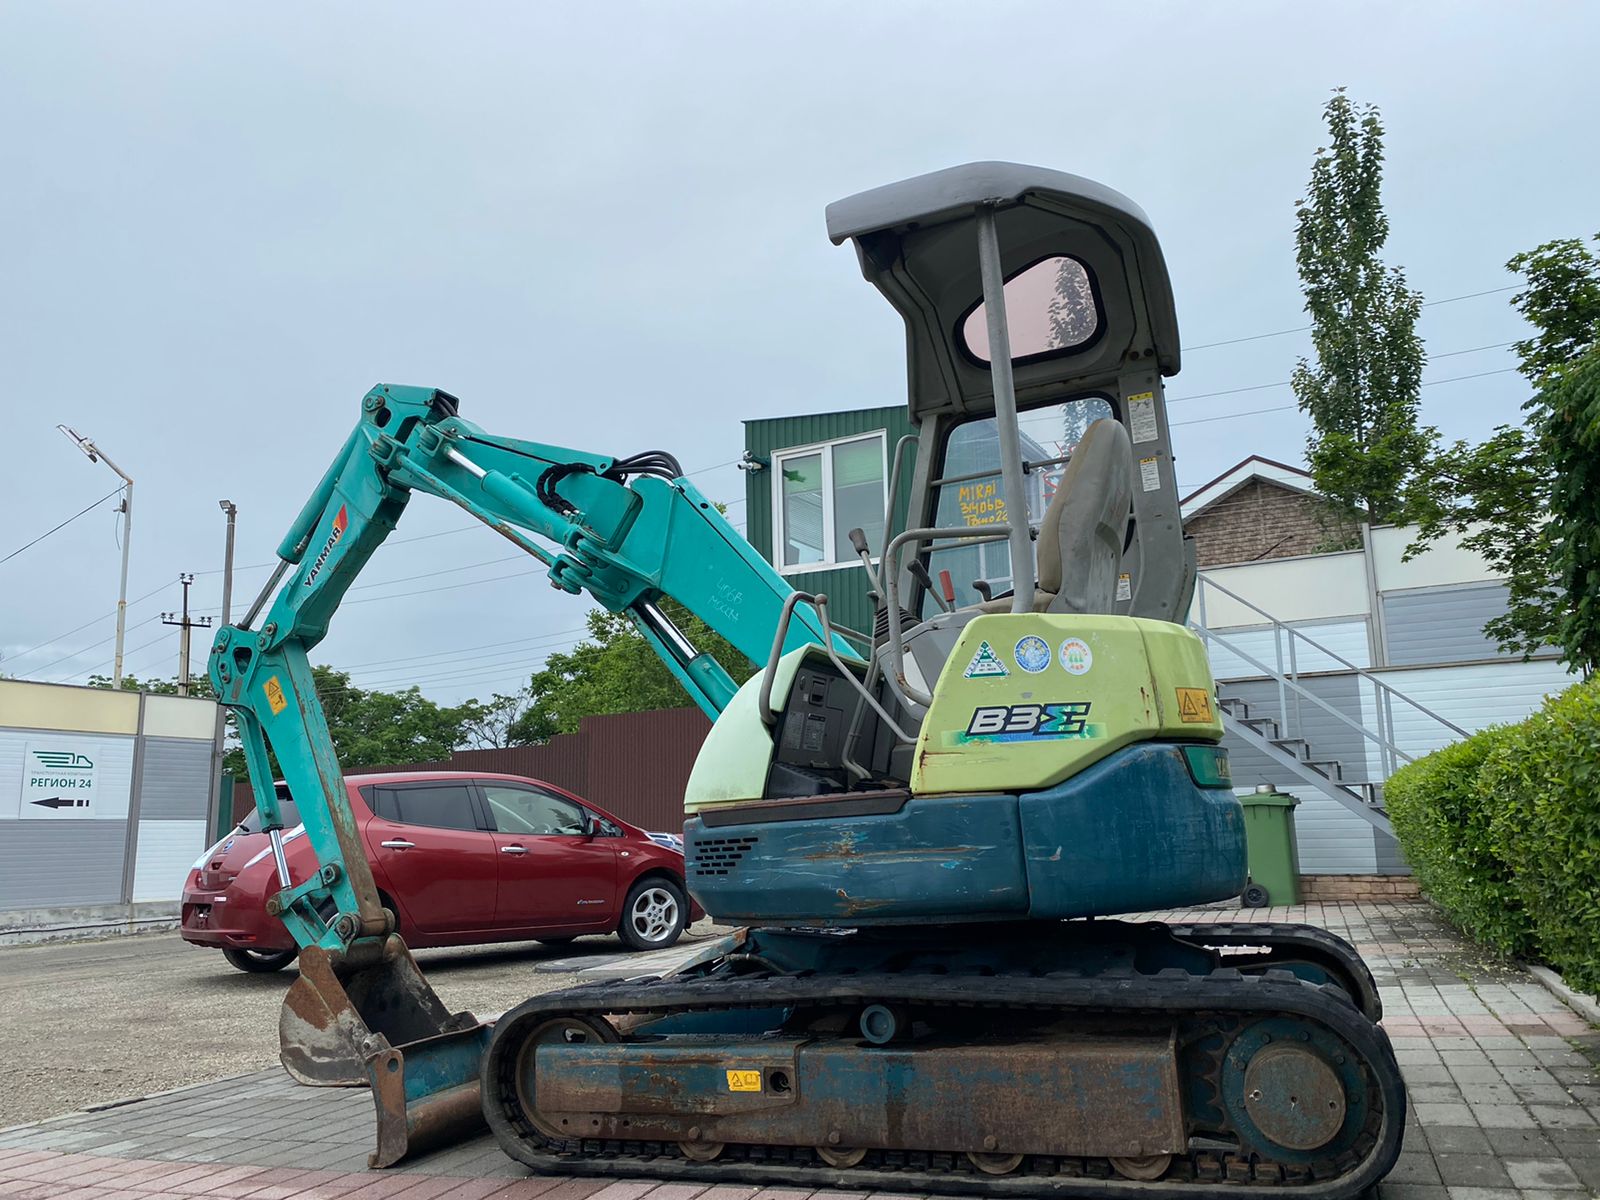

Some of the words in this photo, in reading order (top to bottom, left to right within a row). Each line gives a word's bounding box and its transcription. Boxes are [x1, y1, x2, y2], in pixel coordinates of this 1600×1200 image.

[303, 526, 342, 587] YANMAR
[30, 777, 77, 788] РЕГИОН
[78, 778, 92, 788] 24
